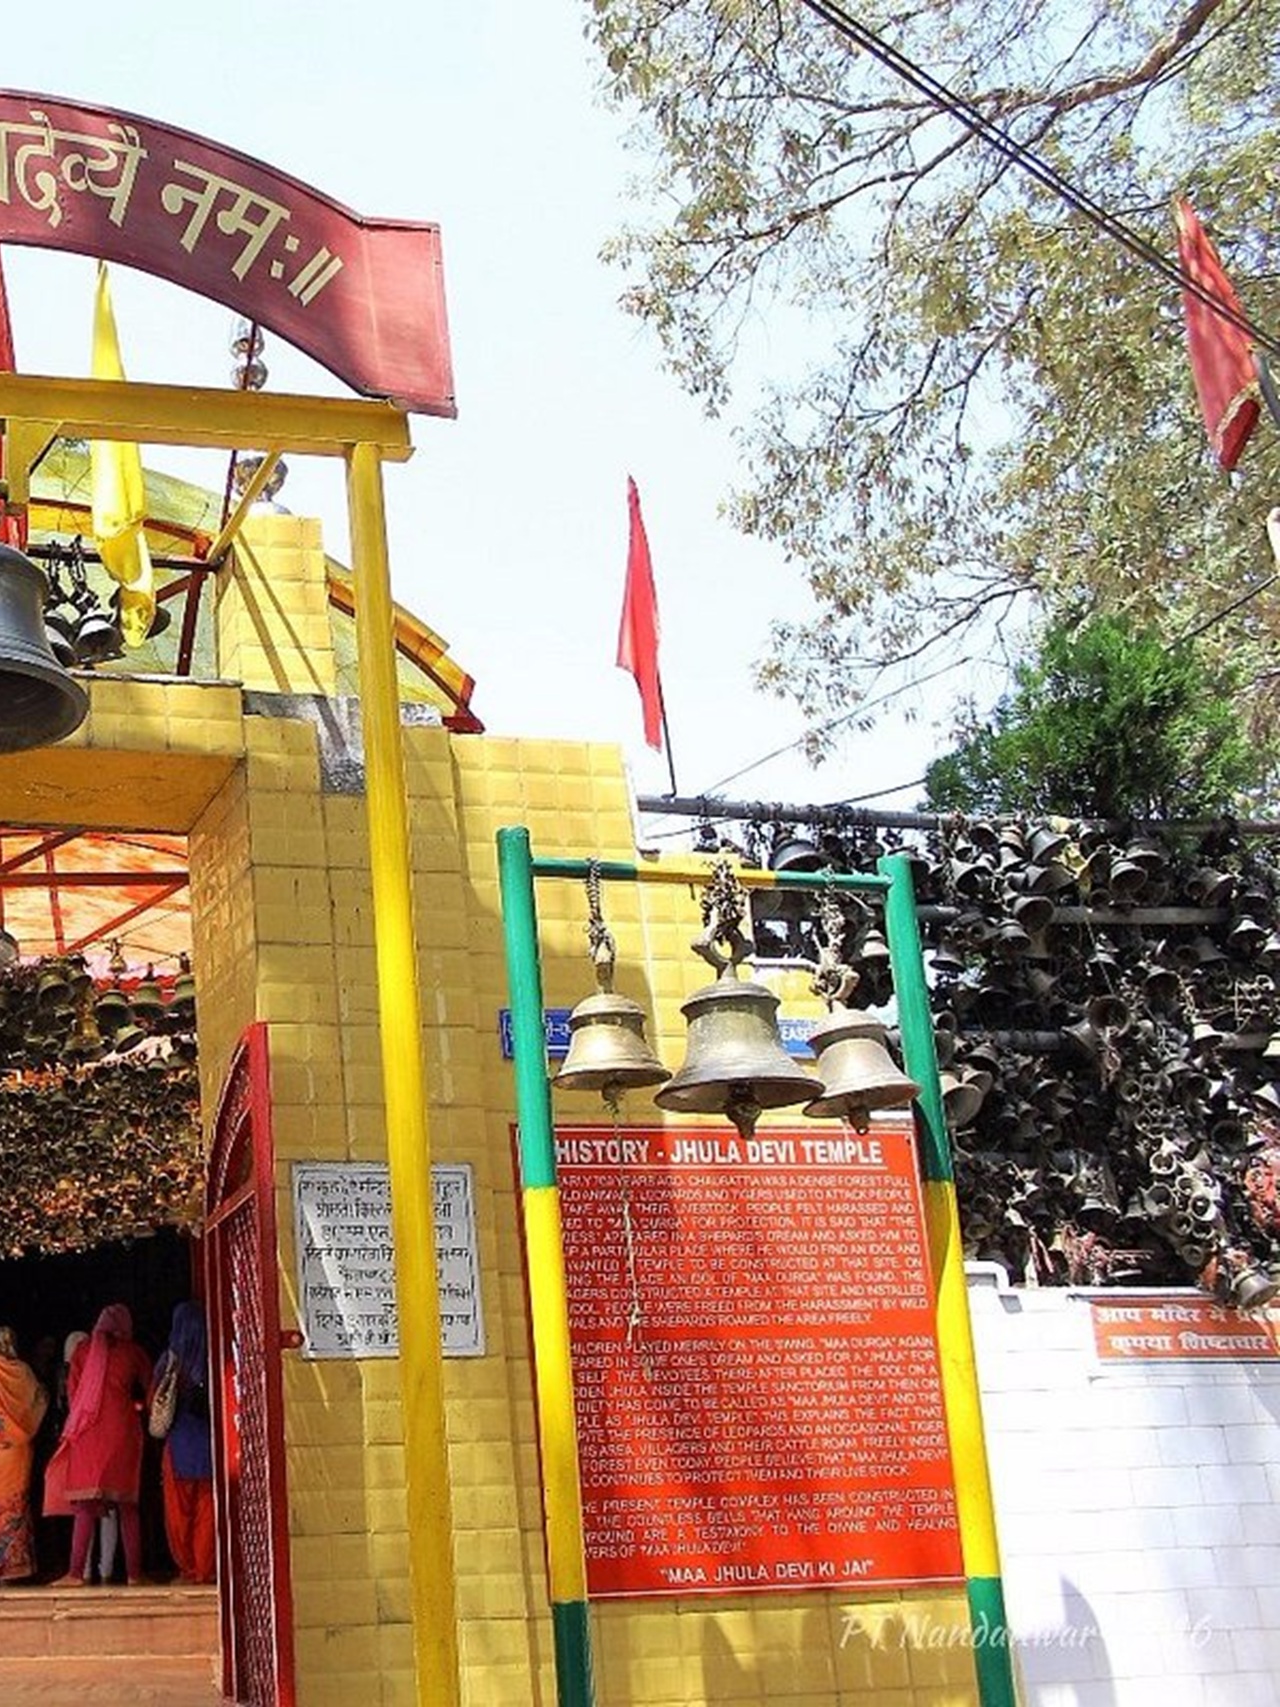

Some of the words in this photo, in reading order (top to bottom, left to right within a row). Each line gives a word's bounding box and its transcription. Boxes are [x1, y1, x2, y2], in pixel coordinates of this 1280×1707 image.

[557, 1140, 651, 1163] HISTORY
[670, 1140, 742, 1163] JHULA
[748, 1140, 797, 1163] DEVI
[801, 1140, 883, 1163] TEMPLE
[714, 1565, 769, 1581] JHULA
[775, 1562, 814, 1578] DEVI
[818, 1561, 835, 1576] KI
